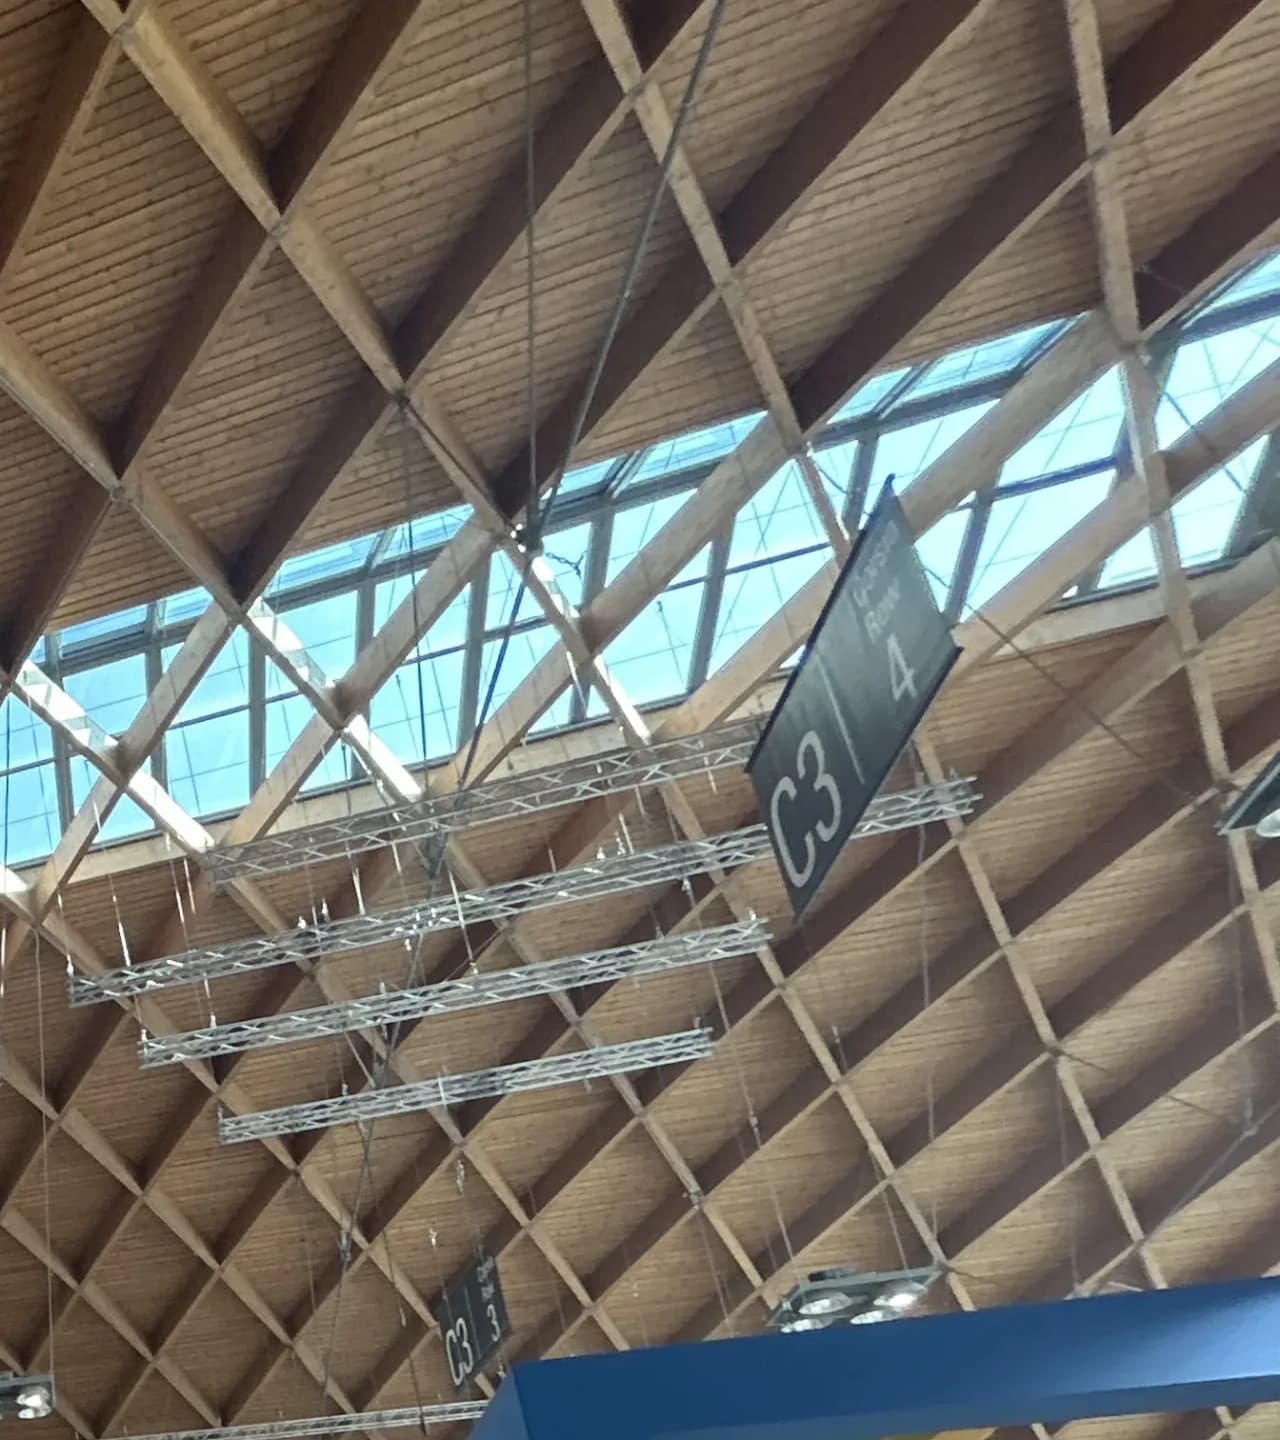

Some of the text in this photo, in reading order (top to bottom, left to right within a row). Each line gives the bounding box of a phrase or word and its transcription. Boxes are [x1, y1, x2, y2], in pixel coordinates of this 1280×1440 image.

[886, 633, 918, 701] 4
[771, 730, 841, 888] C3
[445, 1317, 474, 1387] C3
[486, 1304, 502, 1343] 3
